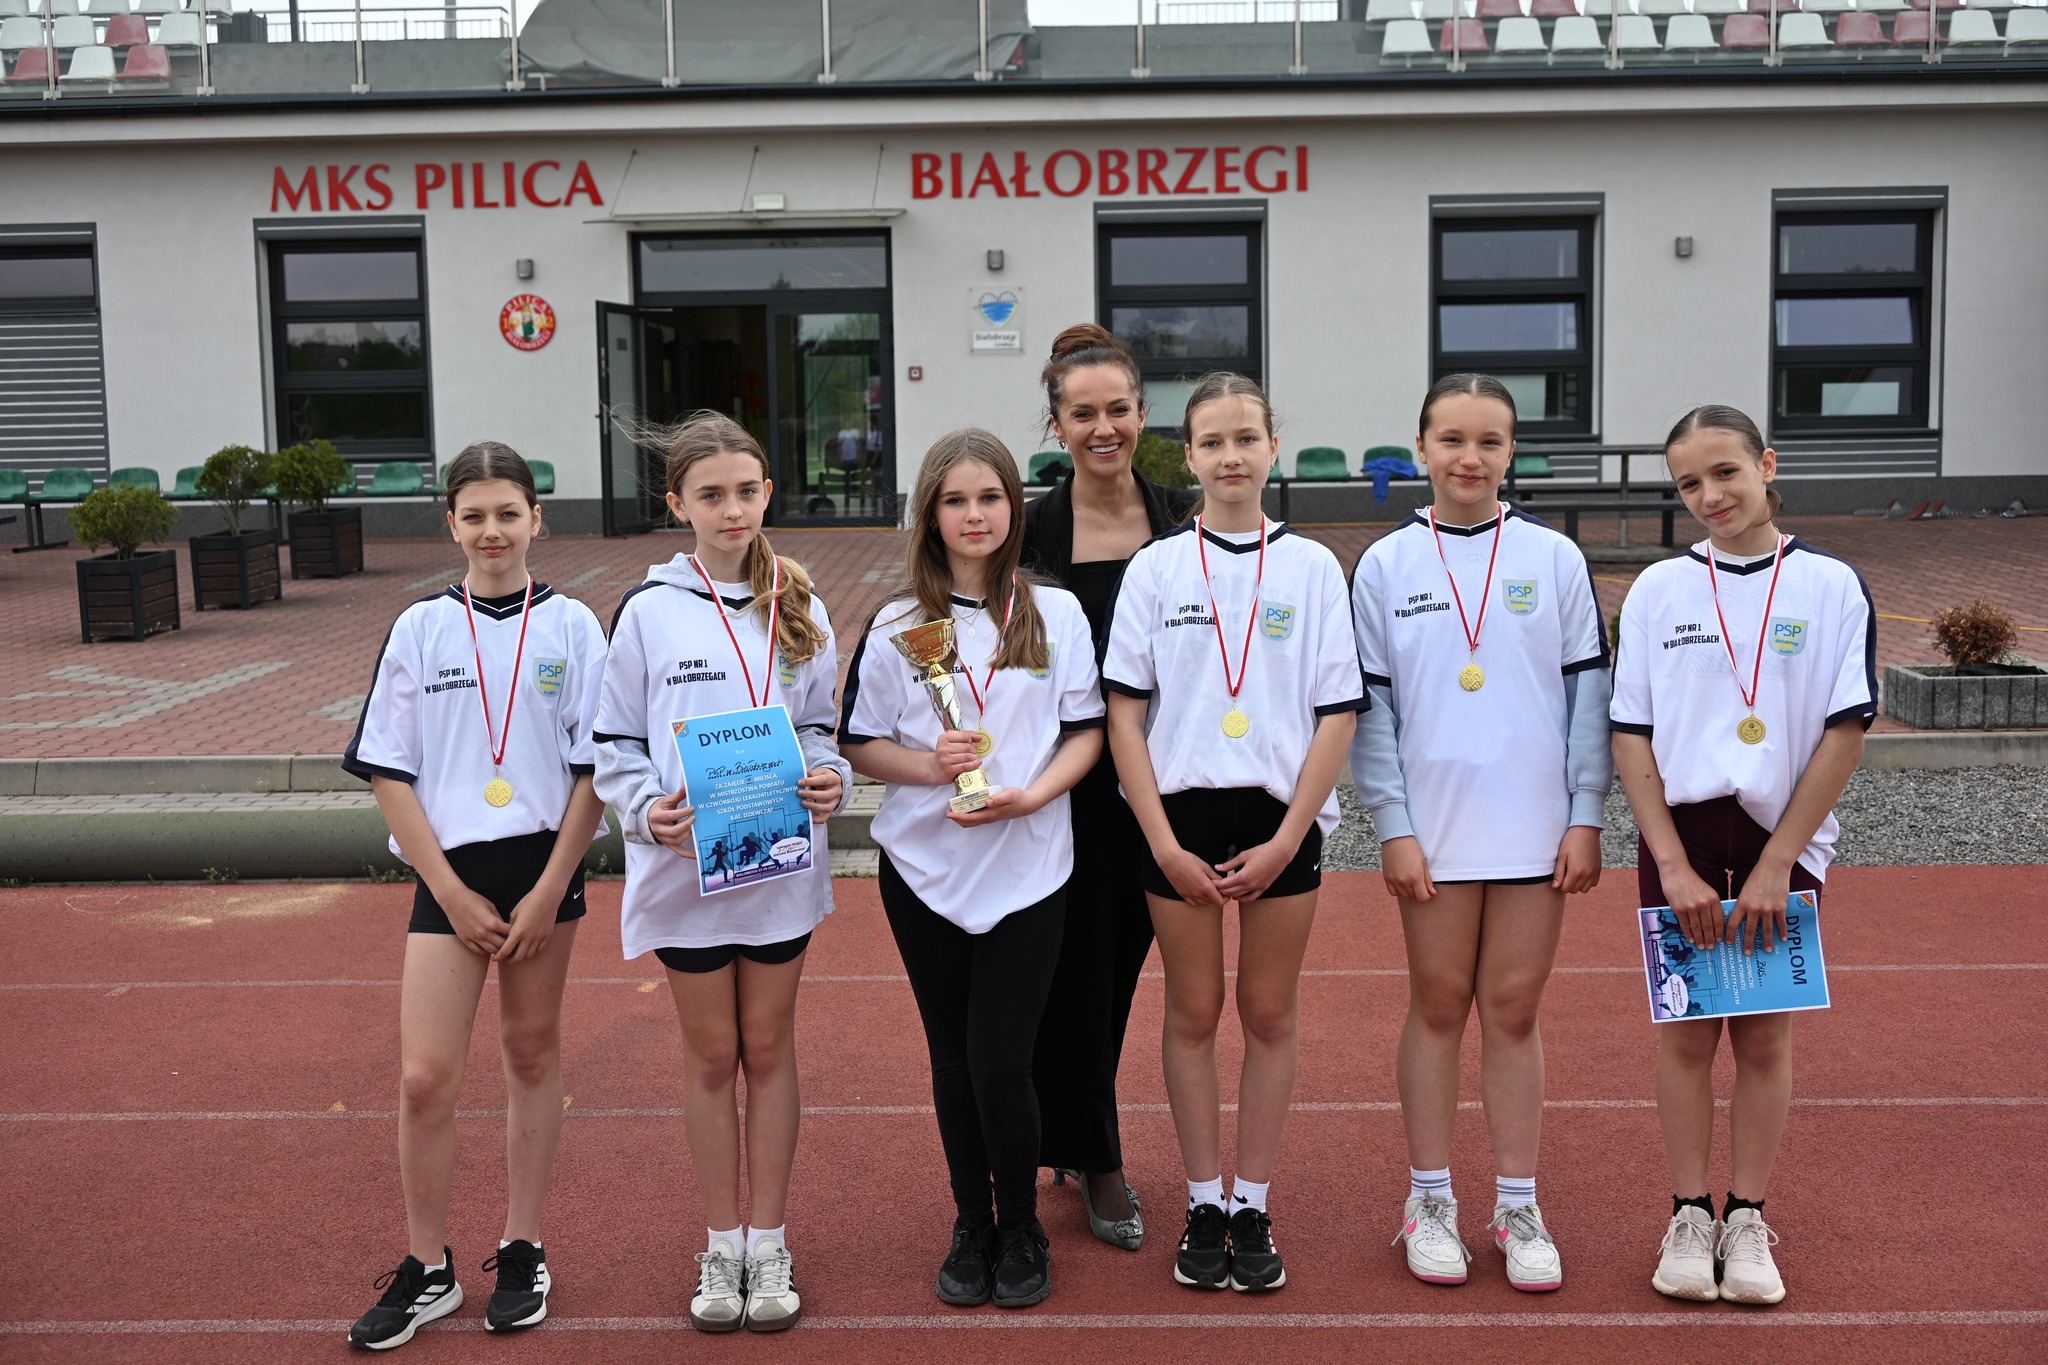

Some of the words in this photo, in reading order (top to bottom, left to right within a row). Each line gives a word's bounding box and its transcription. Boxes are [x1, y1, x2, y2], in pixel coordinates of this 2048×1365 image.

[911, 145, 1308, 199] BIAŁOBRZEGI
[270, 163, 393, 212] MKS
[415, 160, 604, 209] PILICA
[505, 295, 548, 313] PILICA
[1408, 592, 1419, 605] PSP
[1420, 593, 1429, 603] NR
[1429, 592, 1433, 600] 1
[1508, 585, 1532, 598] PSP
[1179, 604, 1190, 615] PSP
[1191, 604, 1200, 613] NR
[1201, 605, 1204, 613] 1
[1266, 607, 1290, 622] PSP
[1395, 609, 1400, 618] W
[1401, 602, 1450, 618] BIAŁOBRZEGACH
[1164, 620, 1169, 628] W
[1170, 616, 1217, 628] BIAŁOBRZEGAC
[1675, 624, 1687, 635] PSP
[1687, 623, 1697, 632] NR
[1697, 623, 1702, 632] 1
[1775, 623, 1802, 638] PSP
[1663, 641, 1669, 650] W
[1670, 634, 1720, 649] BIAŁOBRZEGACH
[538, 664, 563, 677] PSP
[679, 660, 693, 670] PSP
[693, 659, 703, 669] NR
[704, 659, 708, 668] 1
[438, 669, 451, 679] PSP
[451, 668, 461, 677] NR
[461, 667, 466, 676] 1
[666, 677, 672, 686] W
[672, 672, 726, 686] BIAŁOBRZEGACH
[912, 674, 919, 684] W
[424, 685, 431, 694] W
[698, 723, 771, 747] DYPLOM
[724, 779, 745, 788] ZAJĘCIE
[754, 773, 778, 782] MIEJSCA
[717, 785, 758, 798] MISTRZOSTWA
[759, 780, 785, 789] POWIATU
[705, 796, 742, 808] CZWÓRBOJU
[743, 786, 799, 801] LEKKOATLETYCZNYM
[716, 805, 736, 815] SZKÓŁ
[736, 797, 784, 811] PODSTAWOWYCH
[743, 807, 774, 818] DZIEWCZĄT
[1786, 915, 1808, 985] DYPLOM
[1719, 942, 1729, 989] PODSTAWOWYCH
[1745, 955, 1754, 989] WODNICZKI
[1728, 947, 1741, 1005] LEKKOATLETYCZNYM
[1738, 963, 1746, 991] POWIATU
